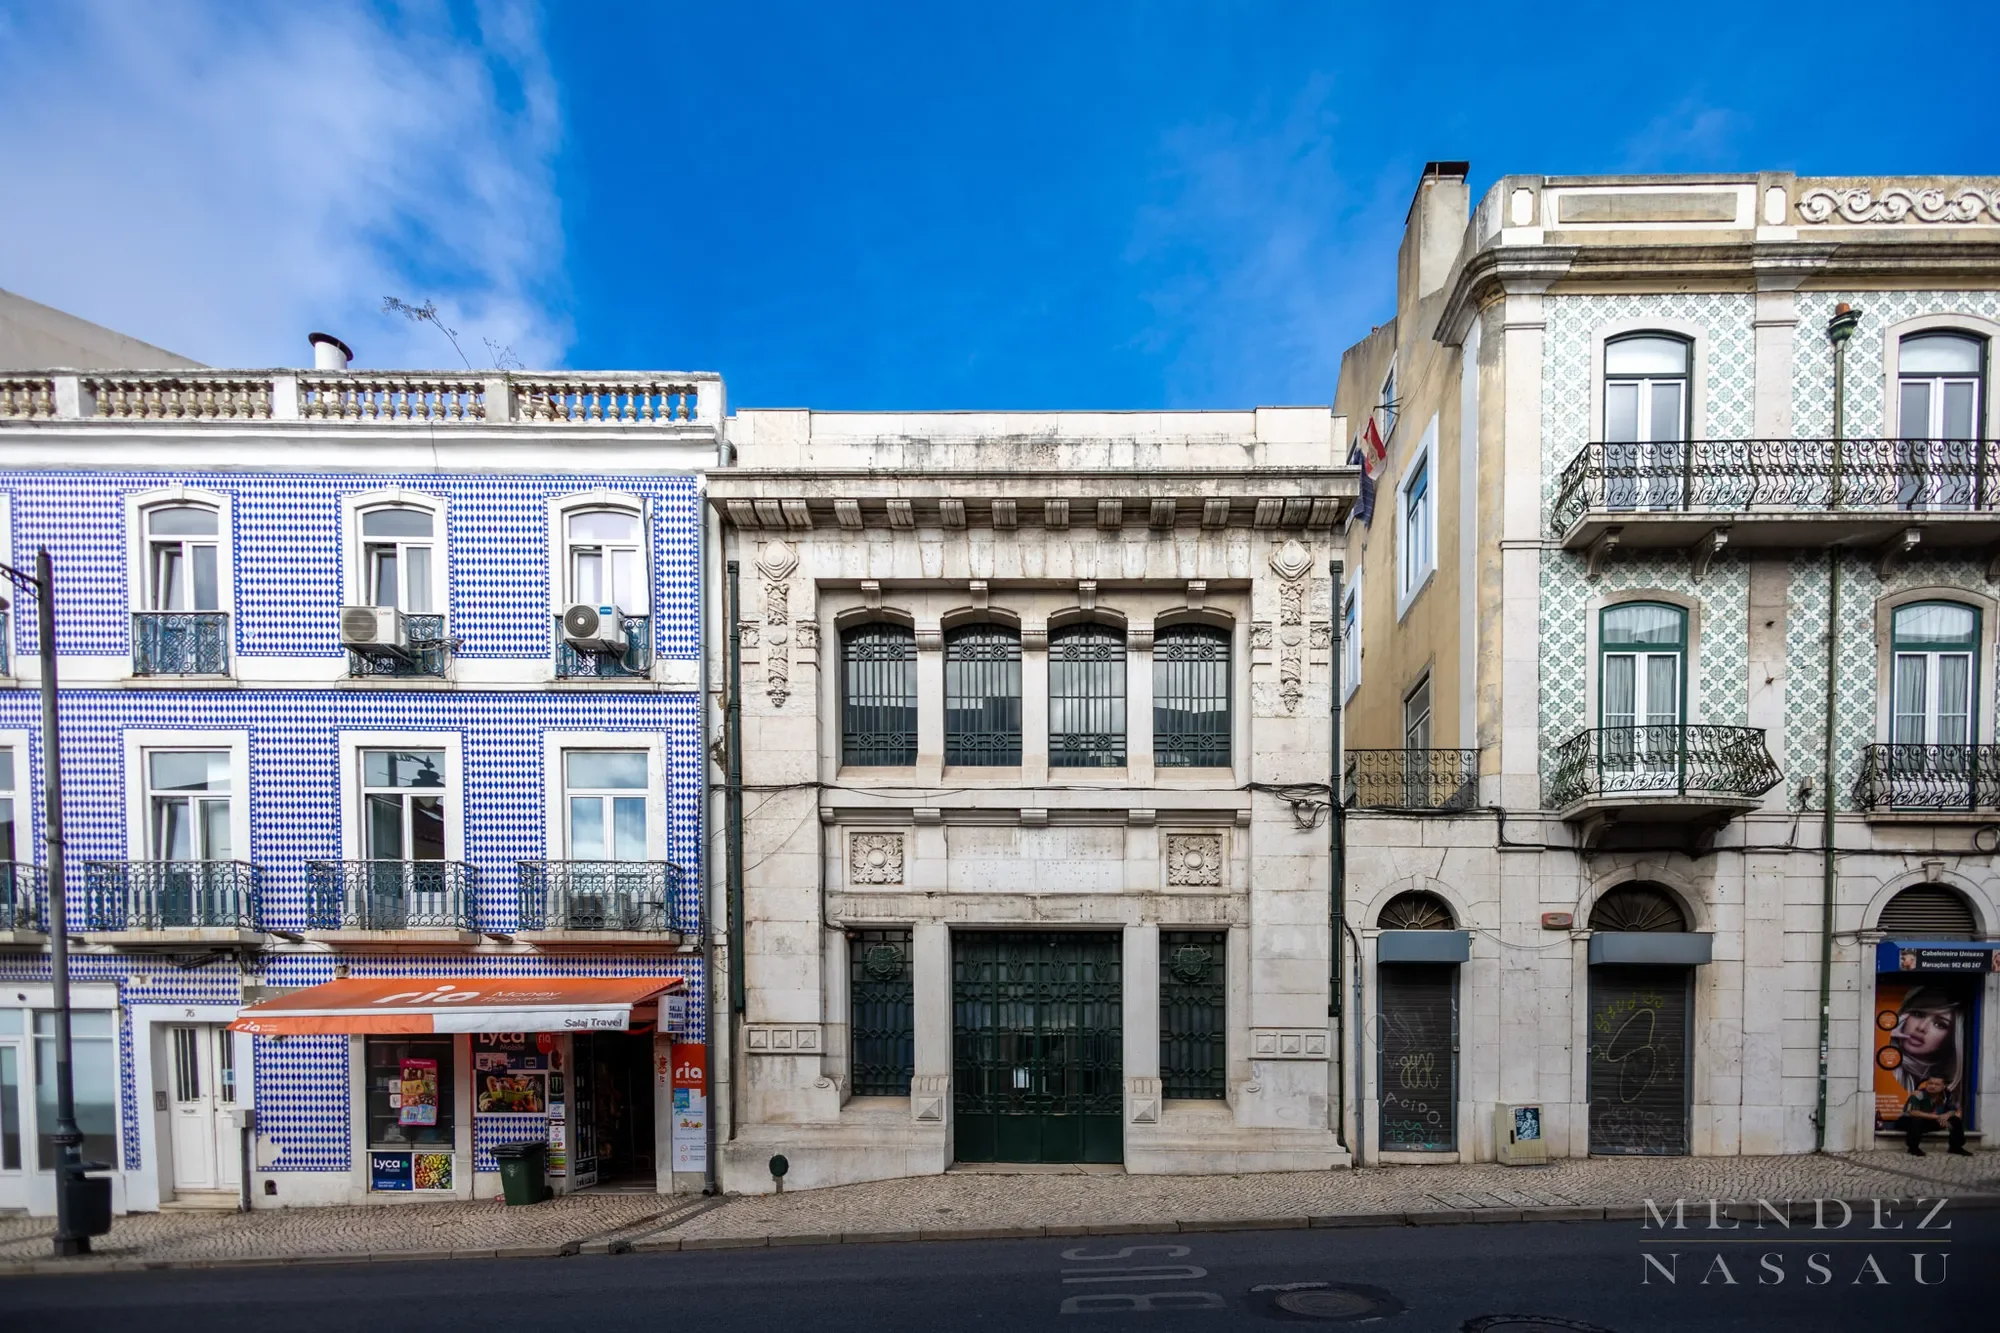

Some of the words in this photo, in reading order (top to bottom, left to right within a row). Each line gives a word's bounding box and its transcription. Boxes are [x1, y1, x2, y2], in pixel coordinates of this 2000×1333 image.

[372, 985, 480, 1004] ria
[235, 1021, 260, 1032] ria
[564, 1018, 588, 1029] Salaj
[591, 1018, 622, 1027] Travel
[480, 1033, 525, 1046] Lyca
[675, 1061, 702, 1078] ria
[374, 1158, 400, 1170] Lyca
[1060, 1244, 1228, 1314] BUS
